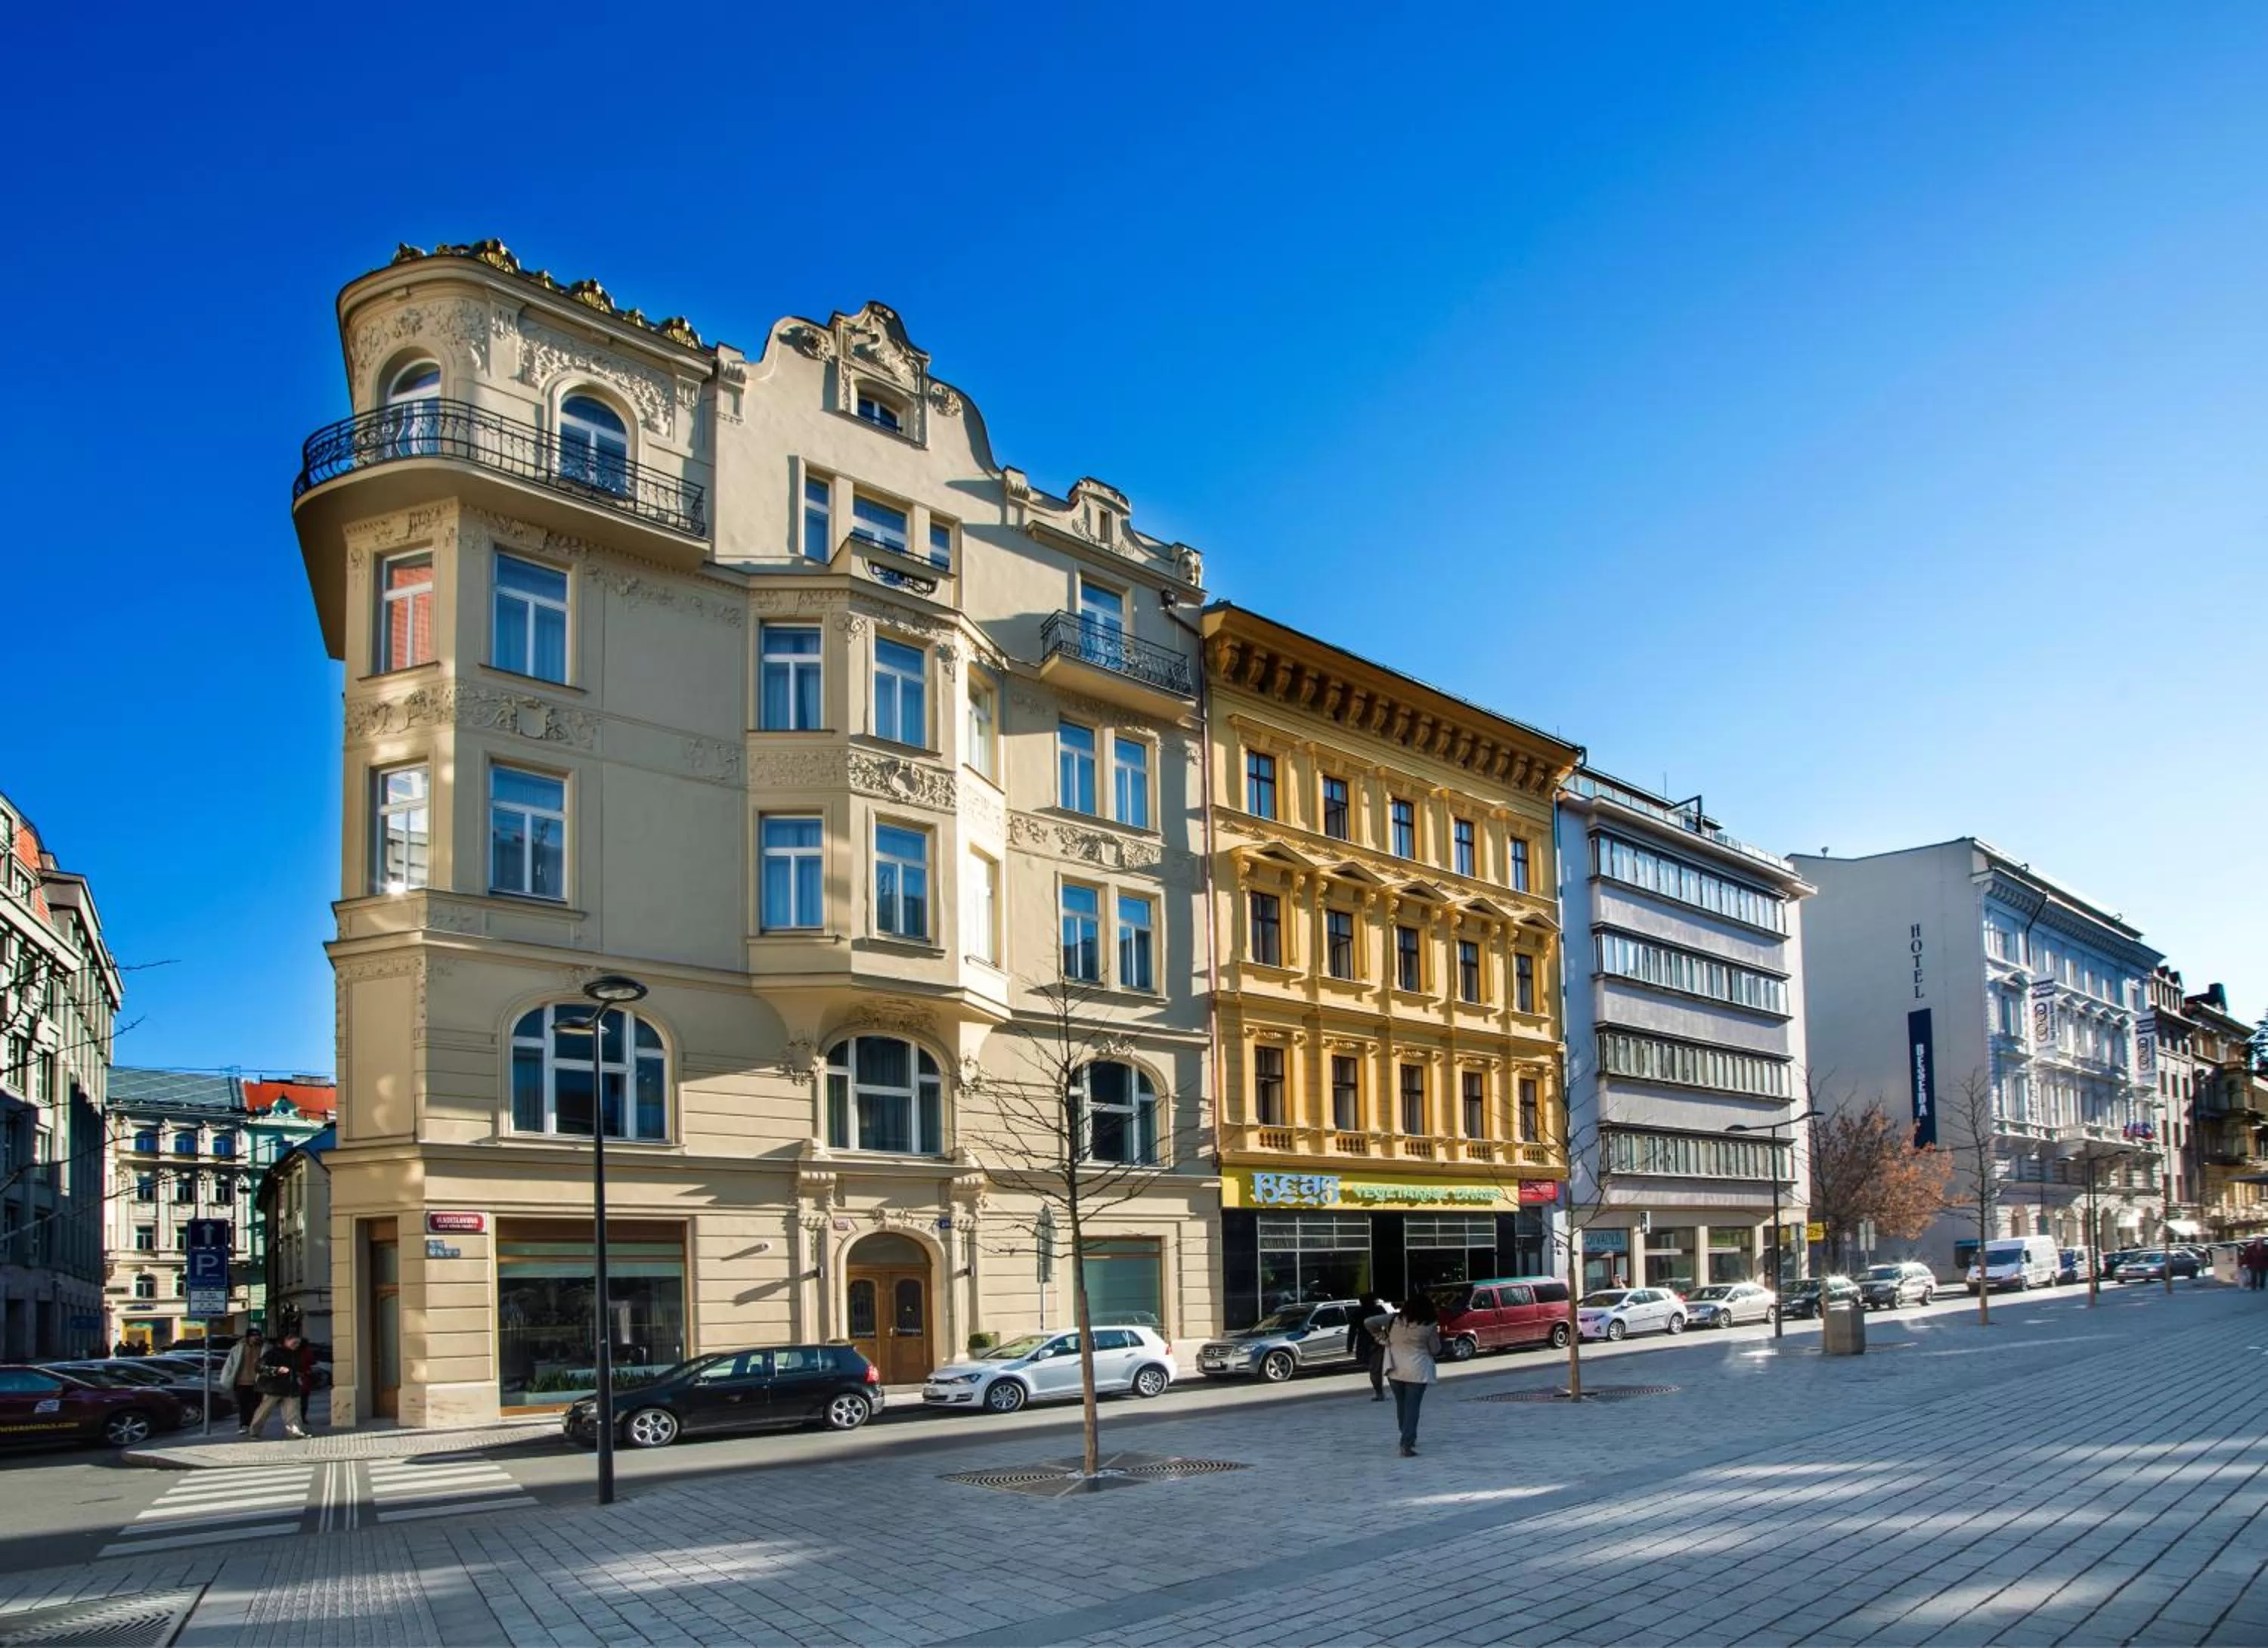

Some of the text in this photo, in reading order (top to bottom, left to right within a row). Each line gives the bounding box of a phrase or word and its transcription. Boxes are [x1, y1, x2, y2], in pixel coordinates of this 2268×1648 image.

[1910, 923, 1926, 999] HOTEL
[1916, 1044, 1928, 1117] BESEDA
[197, 1254, 219, 1277] P
